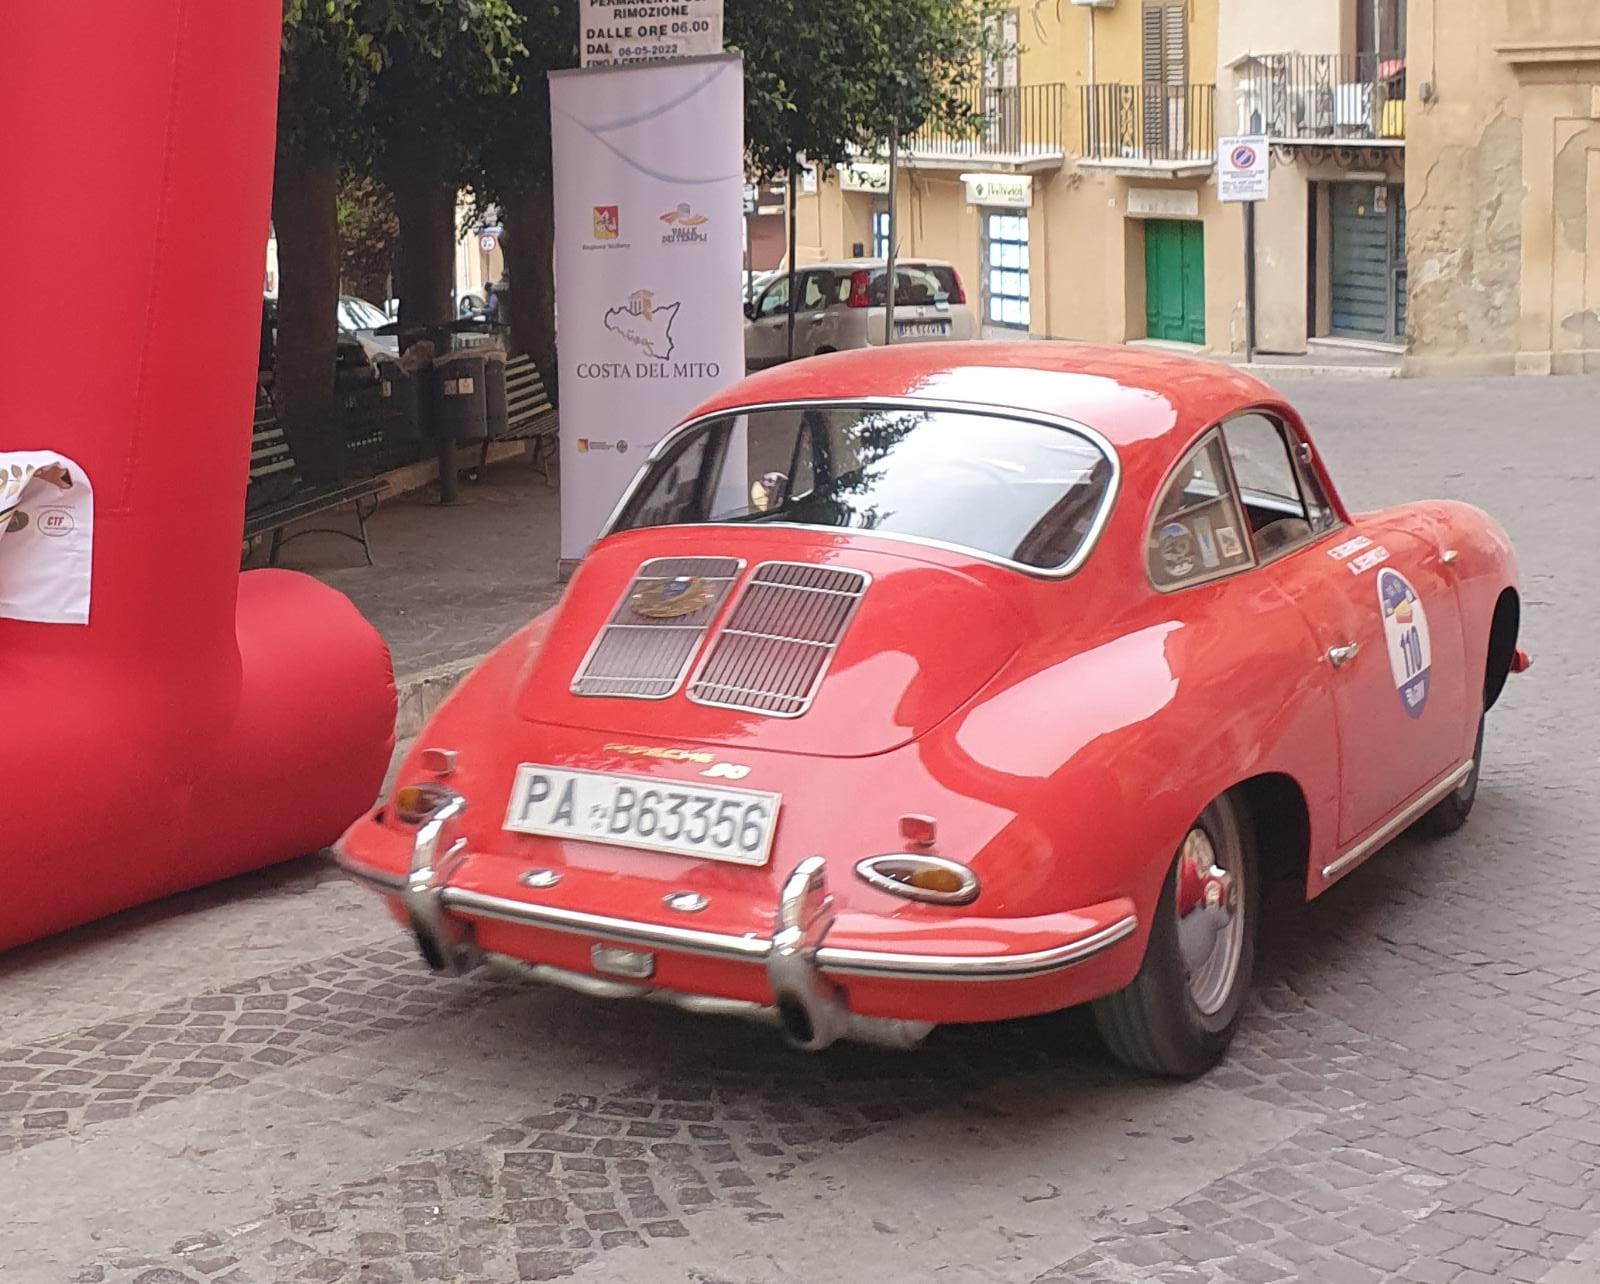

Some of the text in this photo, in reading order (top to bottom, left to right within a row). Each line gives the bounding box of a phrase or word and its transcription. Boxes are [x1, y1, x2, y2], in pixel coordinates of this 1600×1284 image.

[590, 0, 678, 8] PERMA
[613, 5, 689, 20] RIMOZIONE
[586, 27, 631, 39] DALLE
[637, 25, 668, 38] ORE
[586, 44, 613, 55] DAL
[576, 362, 720, 379] COSTA DEL MITO
[47, 516, 65, 526] CTF
[1400, 625, 1423, 678] 110
[520, 774, 769, 852] PA B63356
